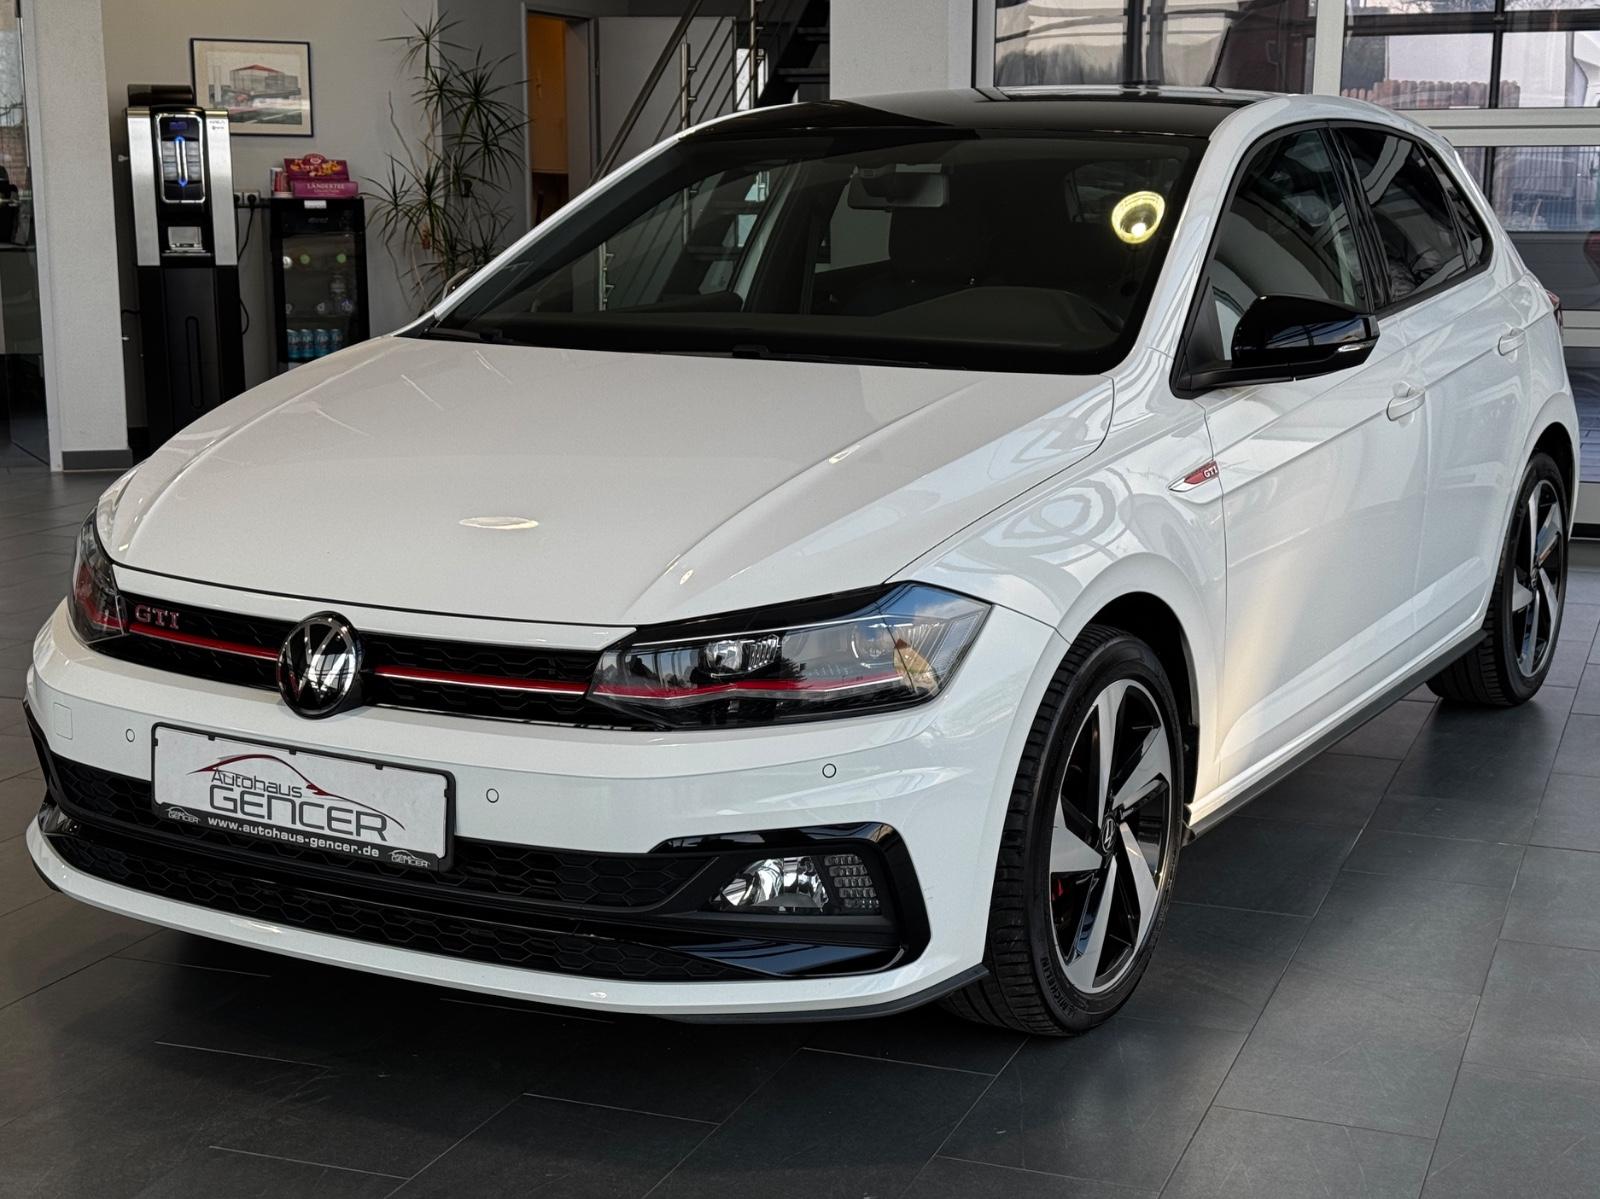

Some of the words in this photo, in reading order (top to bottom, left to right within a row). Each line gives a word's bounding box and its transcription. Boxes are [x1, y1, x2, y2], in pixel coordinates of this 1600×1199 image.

[1203, 465, 1218, 478] GTI
[135, 604, 180, 630] GTI
[210, 768, 303, 798] Autohaus
[209, 784, 388, 842] GENCER
[207, 815, 380, 858] www.autohaus-gencer.de
[1039, 956, 1069, 1011] MICHELIN
